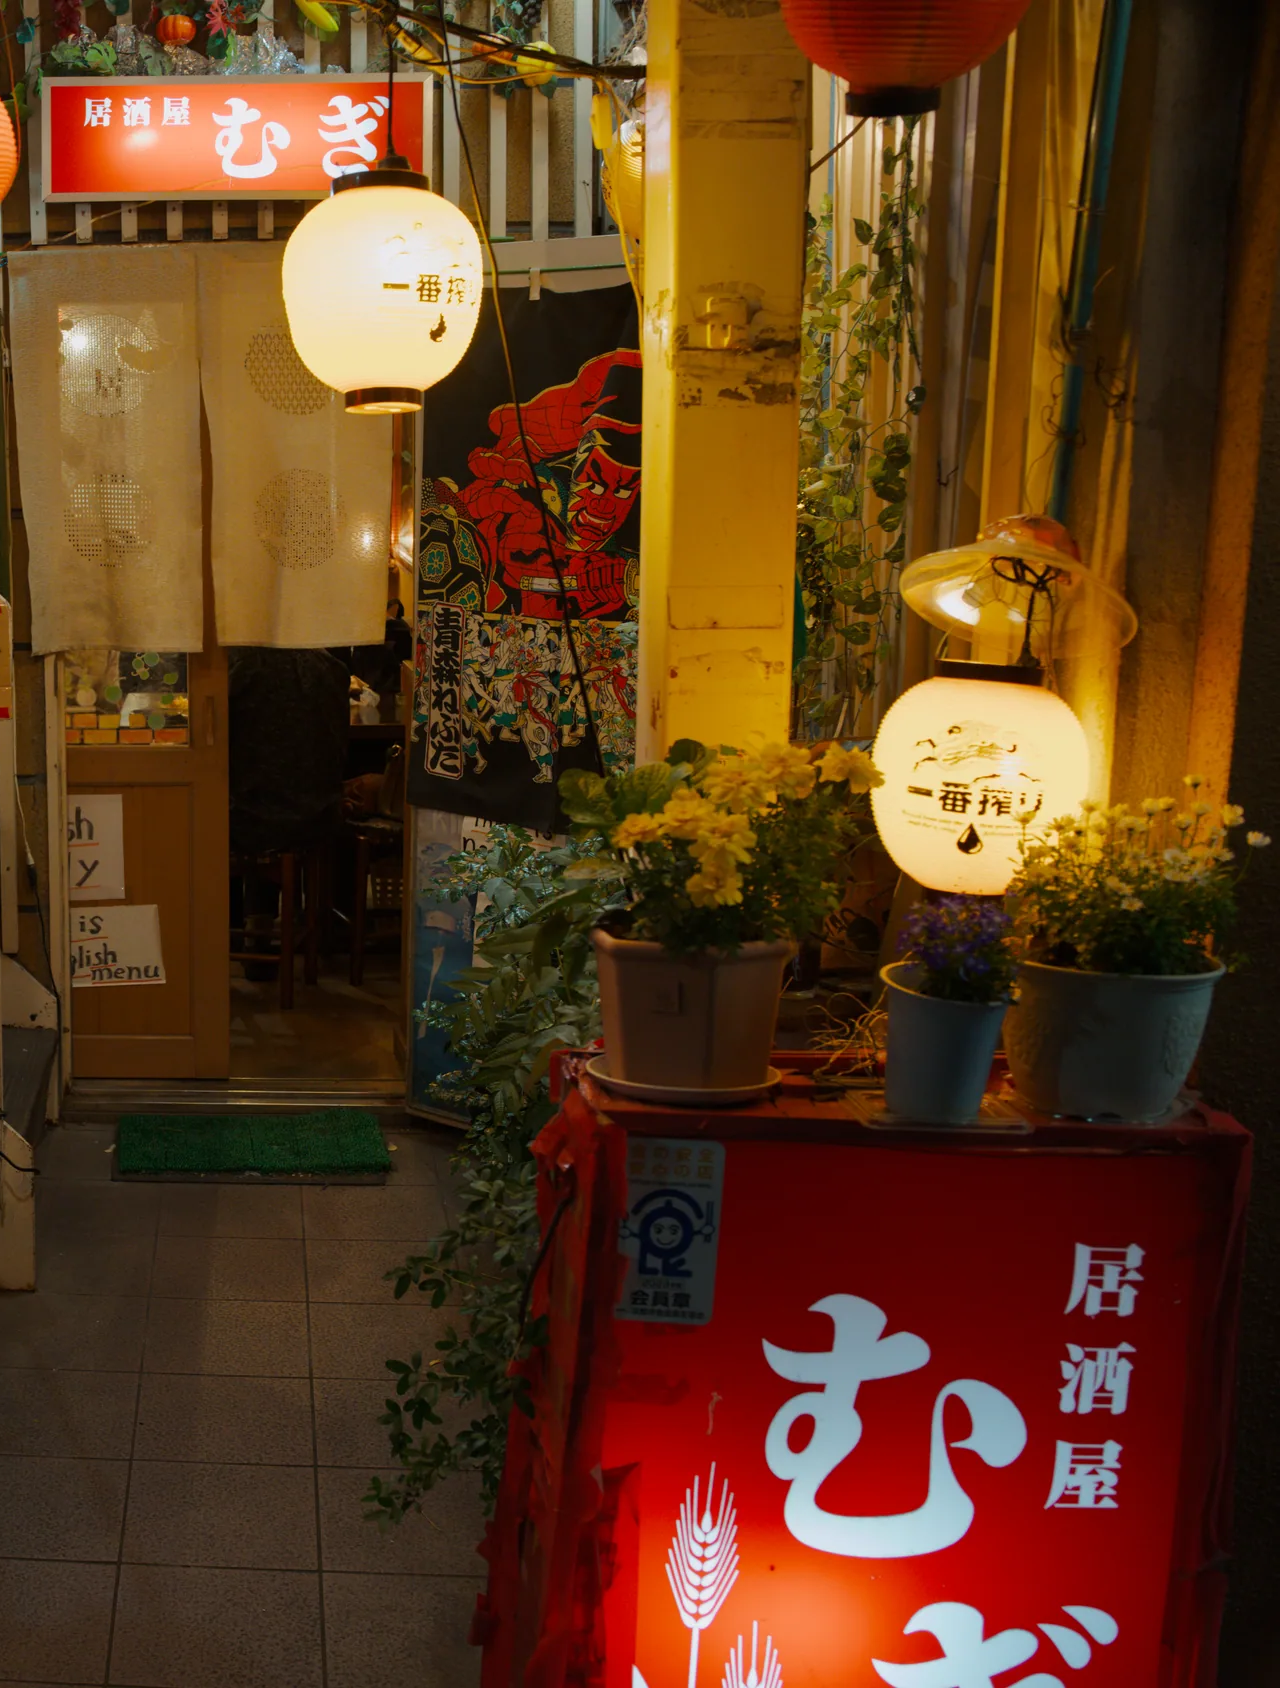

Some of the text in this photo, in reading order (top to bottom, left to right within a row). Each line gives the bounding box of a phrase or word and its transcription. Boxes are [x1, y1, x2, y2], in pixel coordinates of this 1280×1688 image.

[84, 95, 390, 180] 居酒屋 むぎ
[430, 607, 462, 774] 青森ねぶた
[79, 915, 104, 935] is
[91, 965, 160, 981] menu
[1043, 1242, 1147, 1510] 居酒屋
